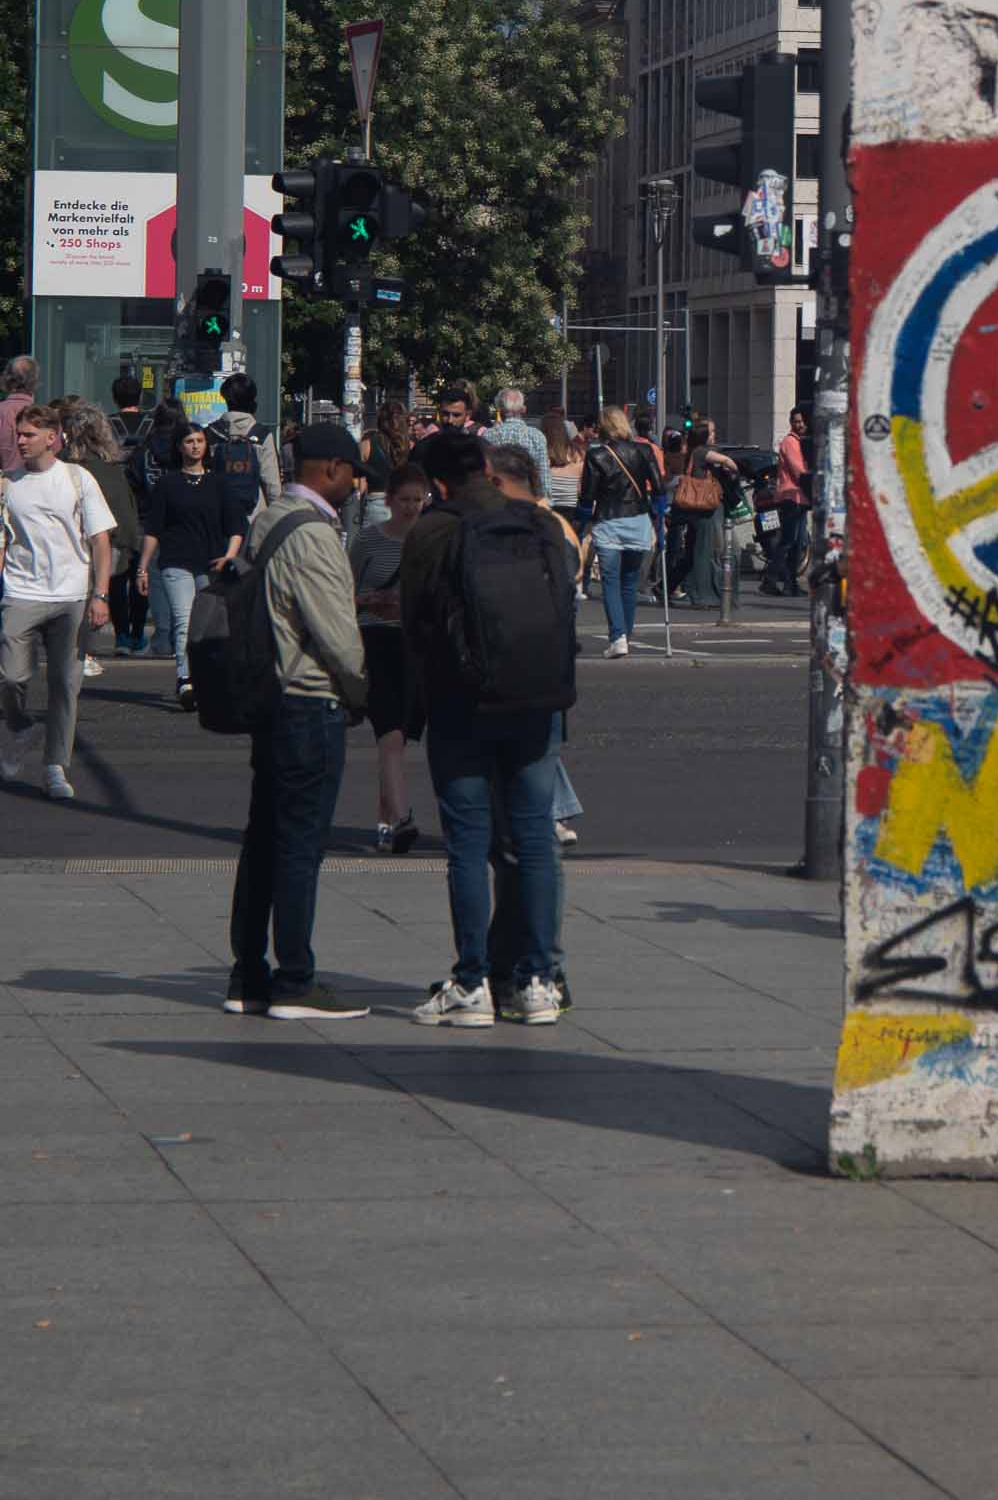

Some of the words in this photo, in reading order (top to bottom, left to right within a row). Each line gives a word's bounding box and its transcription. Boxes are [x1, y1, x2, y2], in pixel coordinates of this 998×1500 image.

[53, 200, 107, 210] Entdecke
[110, 201, 129, 211] die
[47, 213, 135, 223] Markenvielfalt
[51, 227, 74, 235] von
[78, 226, 109, 236] mehr
[112, 226, 130, 236] als
[59, 238, 82, 248] 250
[86, 238, 121, 250] Shops
